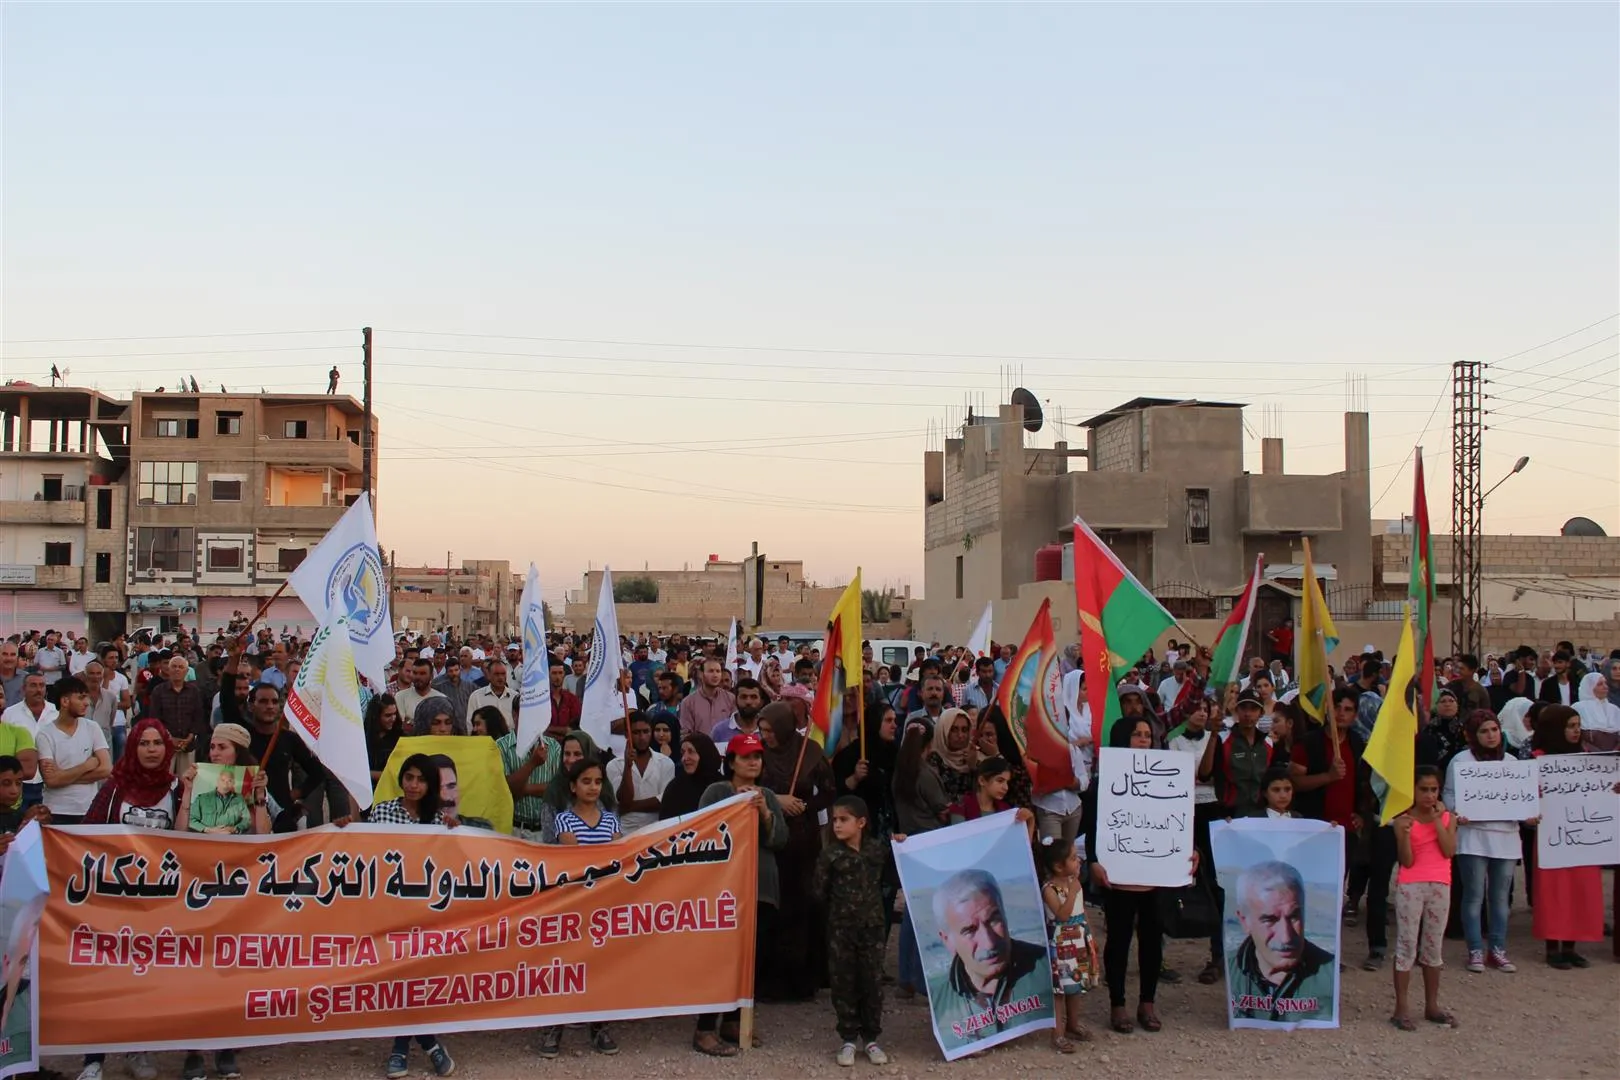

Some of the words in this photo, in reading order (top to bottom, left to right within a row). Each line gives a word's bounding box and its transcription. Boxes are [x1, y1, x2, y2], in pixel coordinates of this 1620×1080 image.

[1133, 753, 1181, 776] كلنا
[1111, 772, 1189, 799] شنكال
[1500, 788, 1509, 804] في
[1581, 779, 1590, 797] في
[1107, 808, 1133, 830] التركي
[1170, 812, 1186, 832] لا
[1565, 806, 1614, 823] كلنا
[1107, 832, 1155, 854] شنكال
[1140, 837, 1182, 858] على
[1549, 826, 1613, 847] شنكال
[624, 821, 733, 883] نستنكر
[66, 848, 182, 907] شنكال
[185, 860, 250, 912] على
[257, 850, 378, 912] التركية
[385, 849, 502, 912] الدولة
[69, 924, 205, 976] ÊRÎŞÊN
[213, 932, 378, 969] DEWLETA
[517, 912, 582, 949] SER
[589, 890, 738, 948] ŞENGALÊ
[245, 986, 297, 1020] EM
[307, 957, 587, 1022] ŞERMEZARDİKİN
